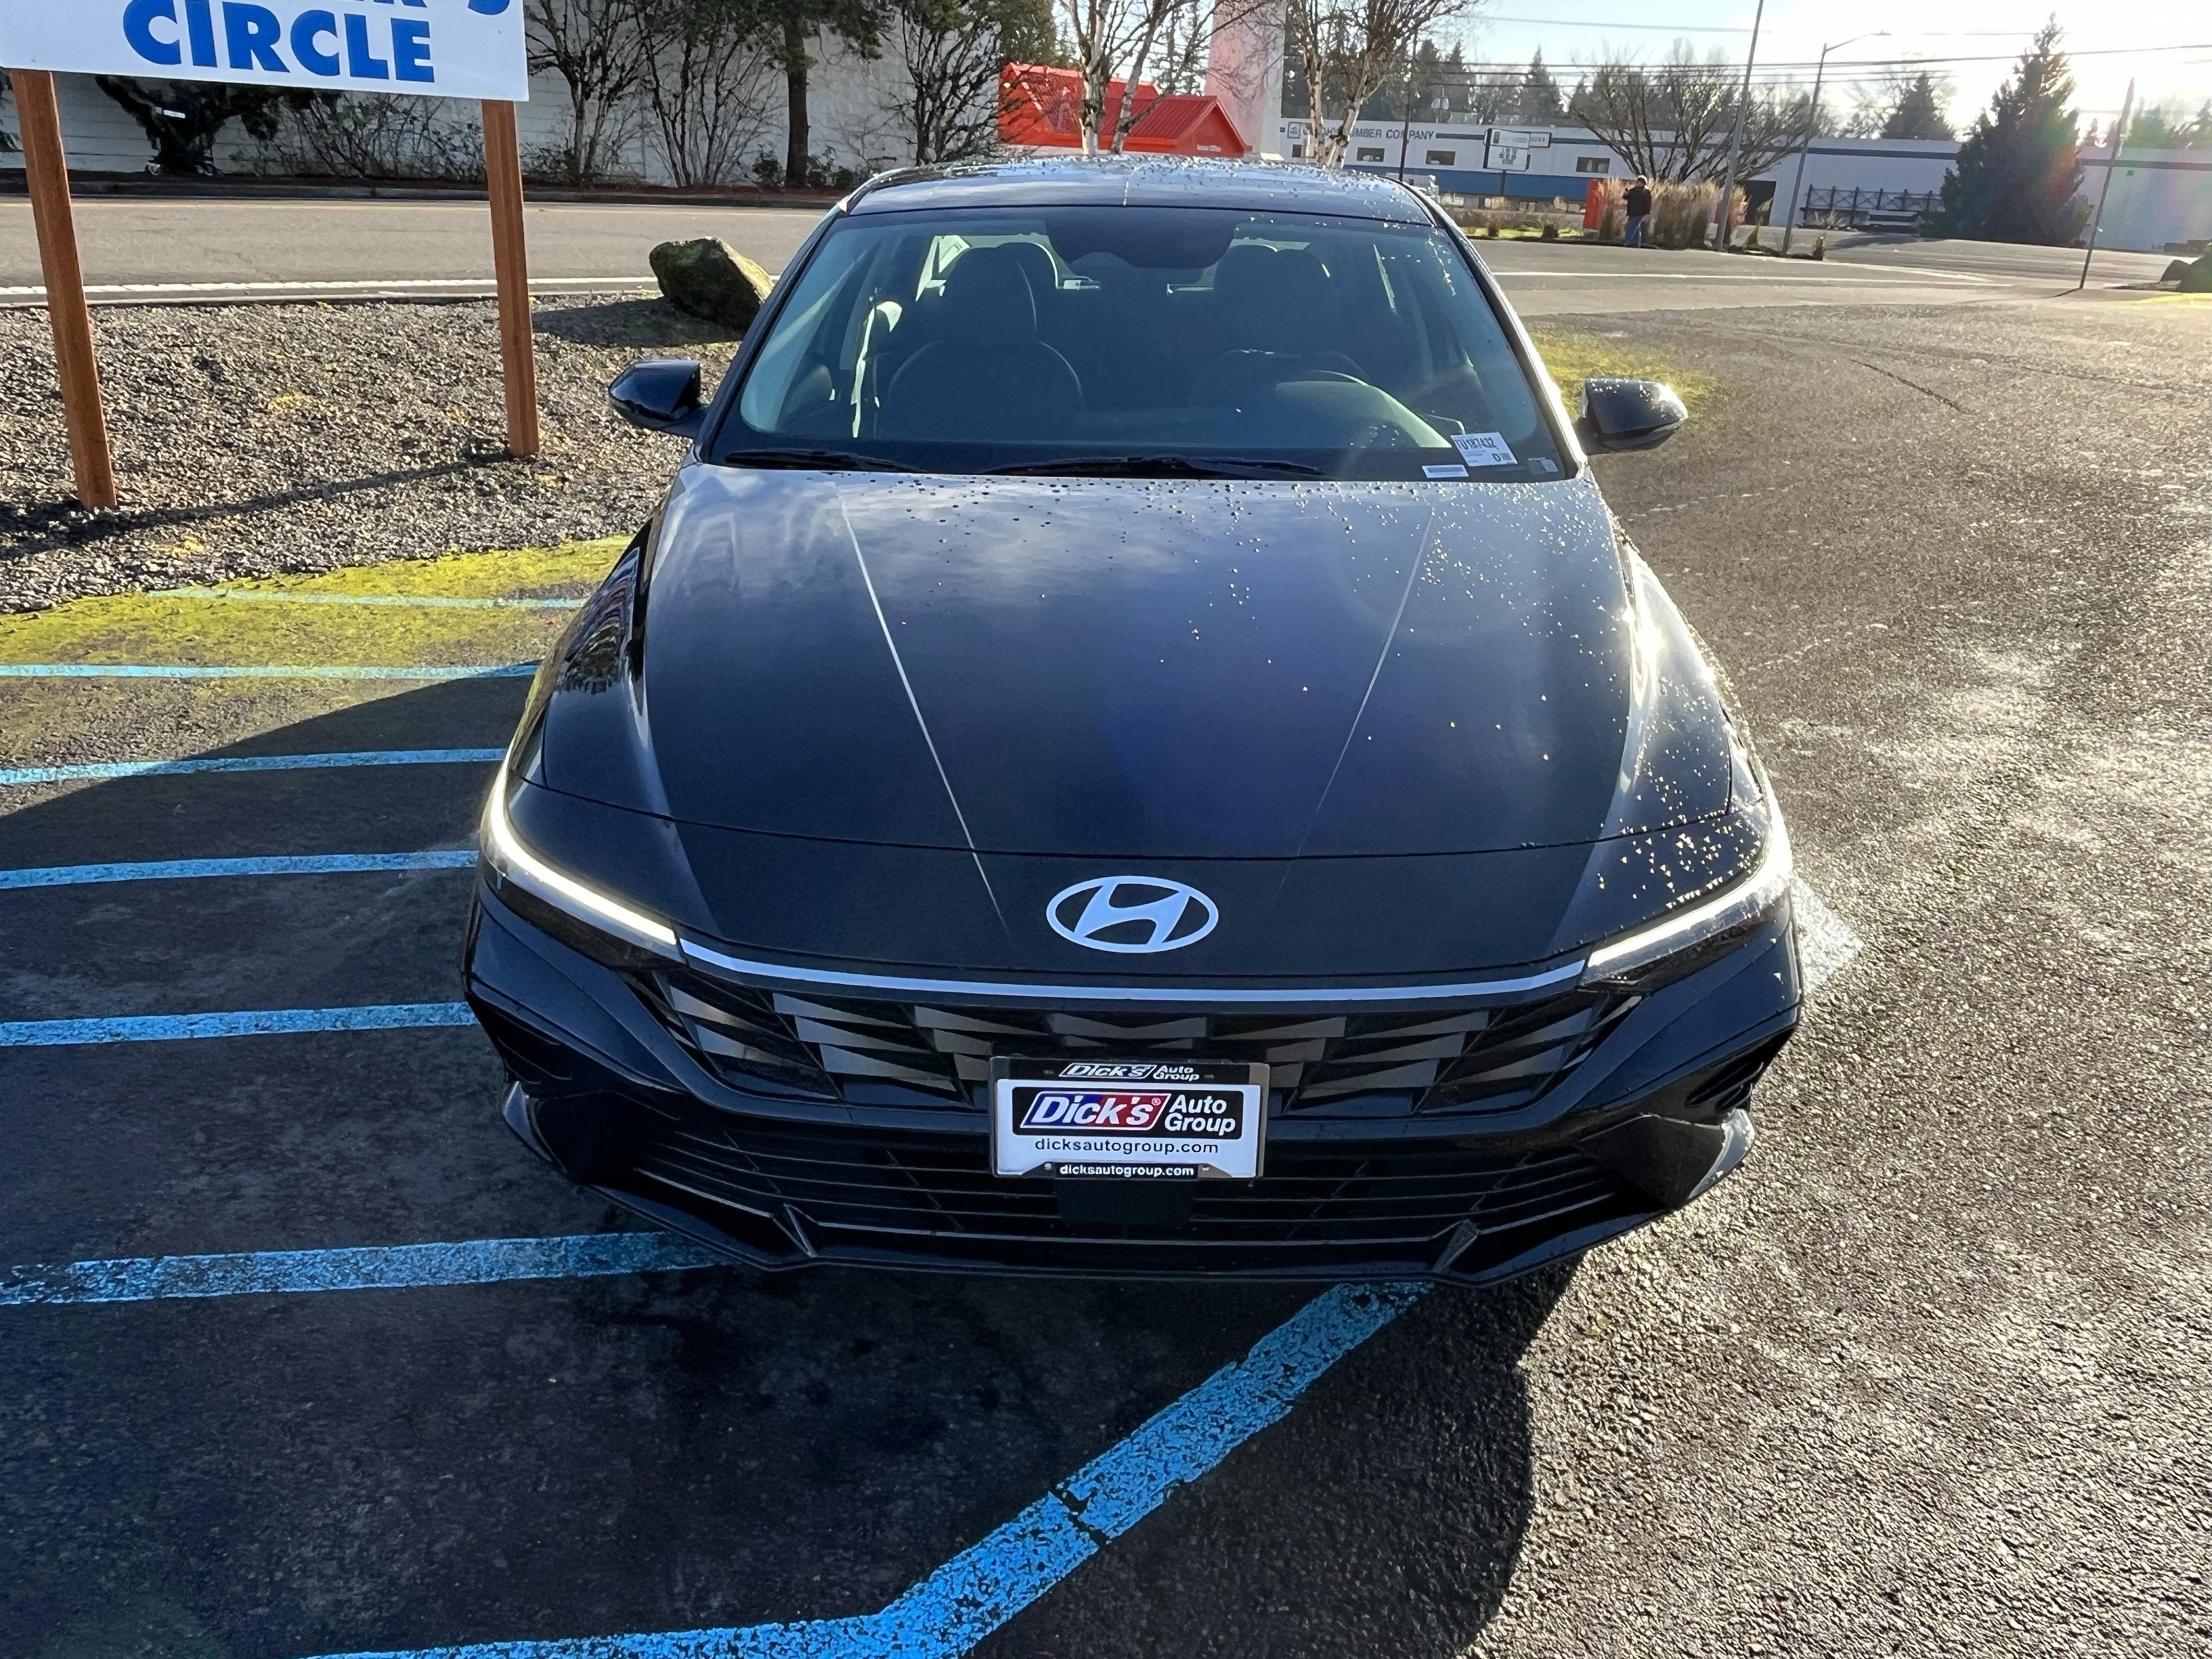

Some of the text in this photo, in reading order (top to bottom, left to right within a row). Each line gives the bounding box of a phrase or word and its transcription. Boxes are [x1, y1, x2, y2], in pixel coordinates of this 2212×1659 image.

[123, 0, 435, 82] CIRCLE
[1347, 128, 1382, 138] UMBER
[1066, 1064, 1150, 1077] Dick's
[1156, 1065, 1194, 1074] Auto
[1153, 1072, 1200, 1082] Group
[1170, 1095, 1227, 1114] Auto
[1164, 1114, 1236, 1136] Group
[1035, 1138, 1218, 1155] dicksautogroup.com
[1060, 1164, 1194, 1177] dicksautogroup.com
